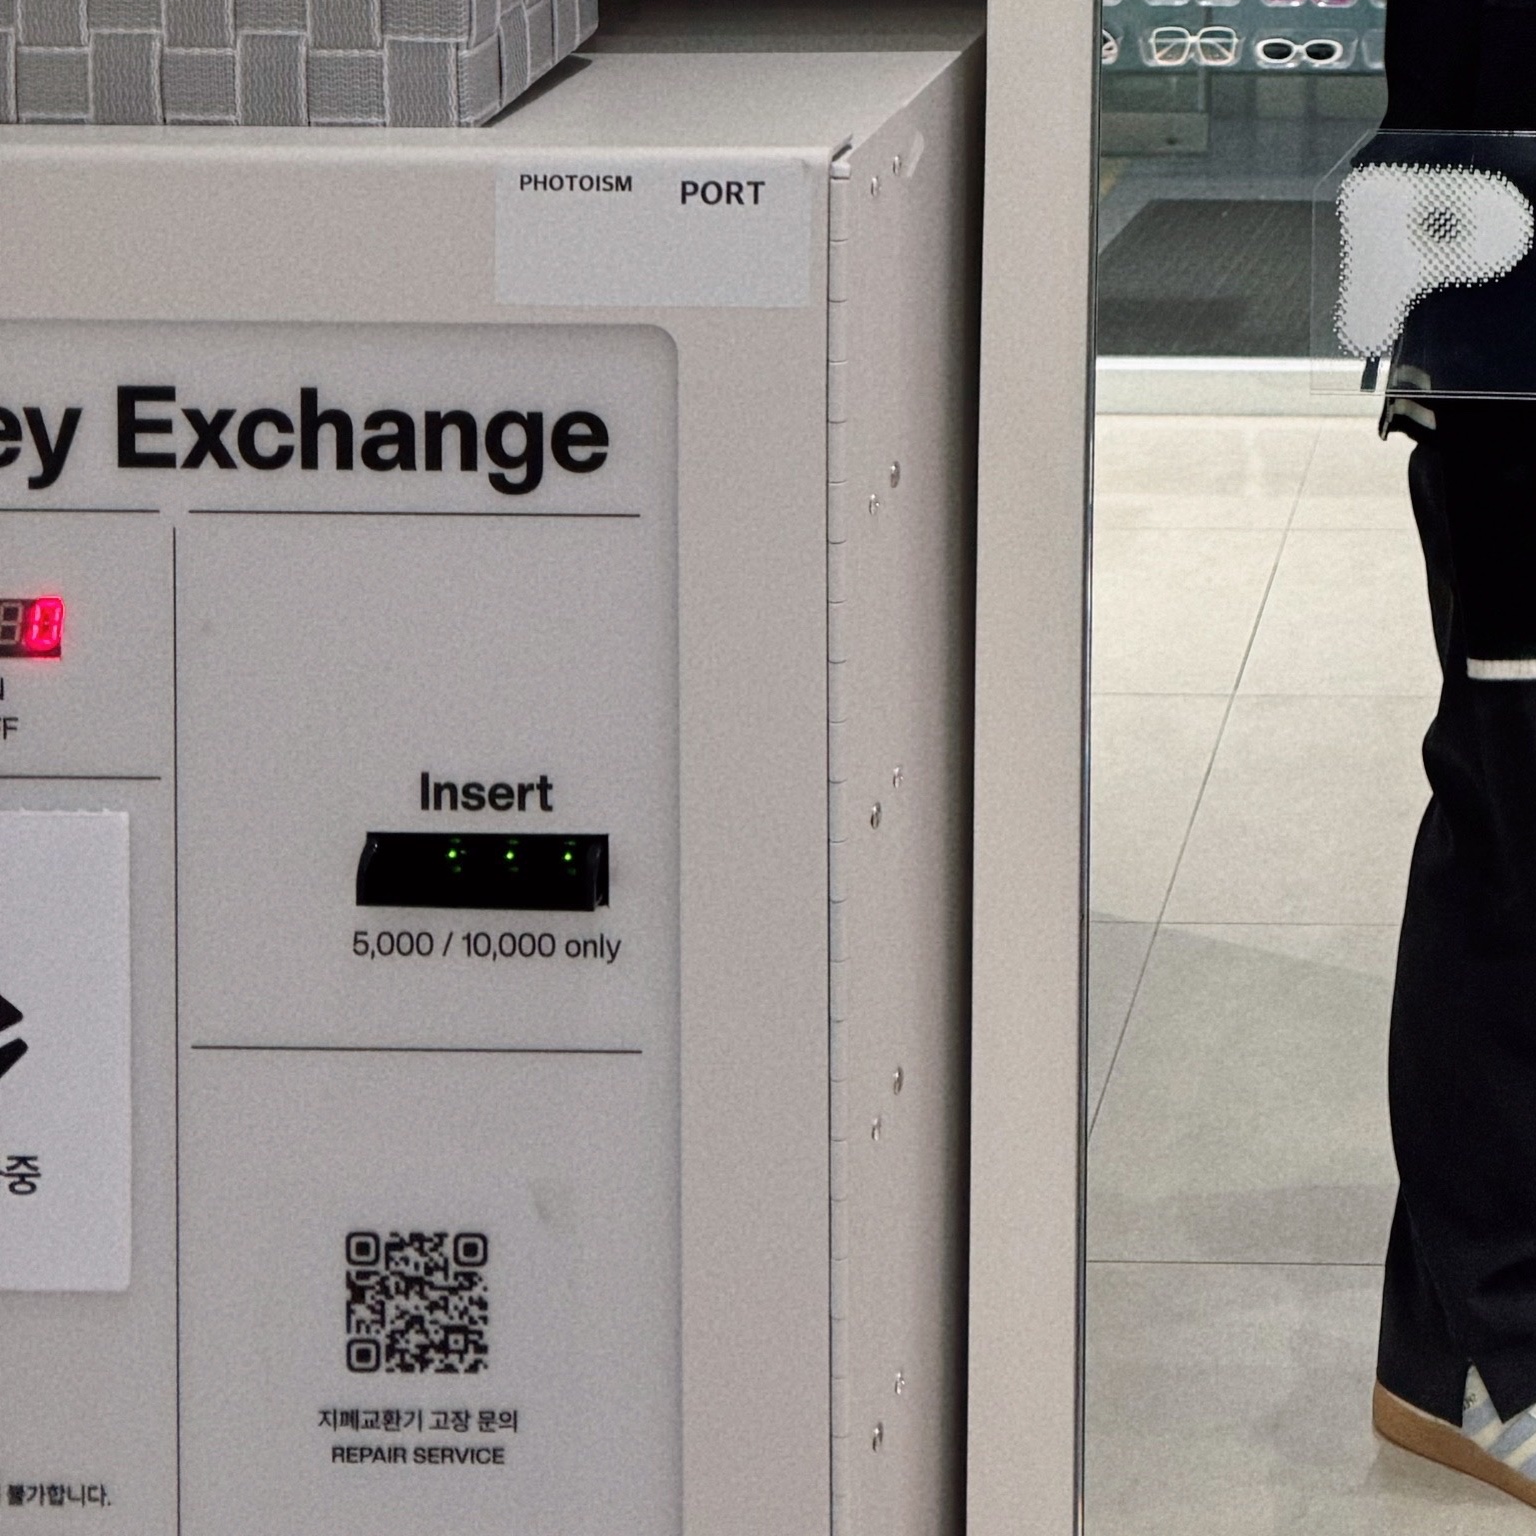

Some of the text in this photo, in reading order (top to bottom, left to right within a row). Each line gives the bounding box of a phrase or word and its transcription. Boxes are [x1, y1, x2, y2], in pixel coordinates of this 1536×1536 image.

[519, 174, 766, 205] PHOTOISM PORT
[117, 385, 609, 496] Exchange
[420, 772, 553, 812] Insert
[353, 931, 622, 964] 5,000 / 10,000 only
[429, 1409, 471, 1433] 고장
[478, 1410, 519, 1434] 문의
[331, 1446, 505, 1465] REPAIR SERVICE
